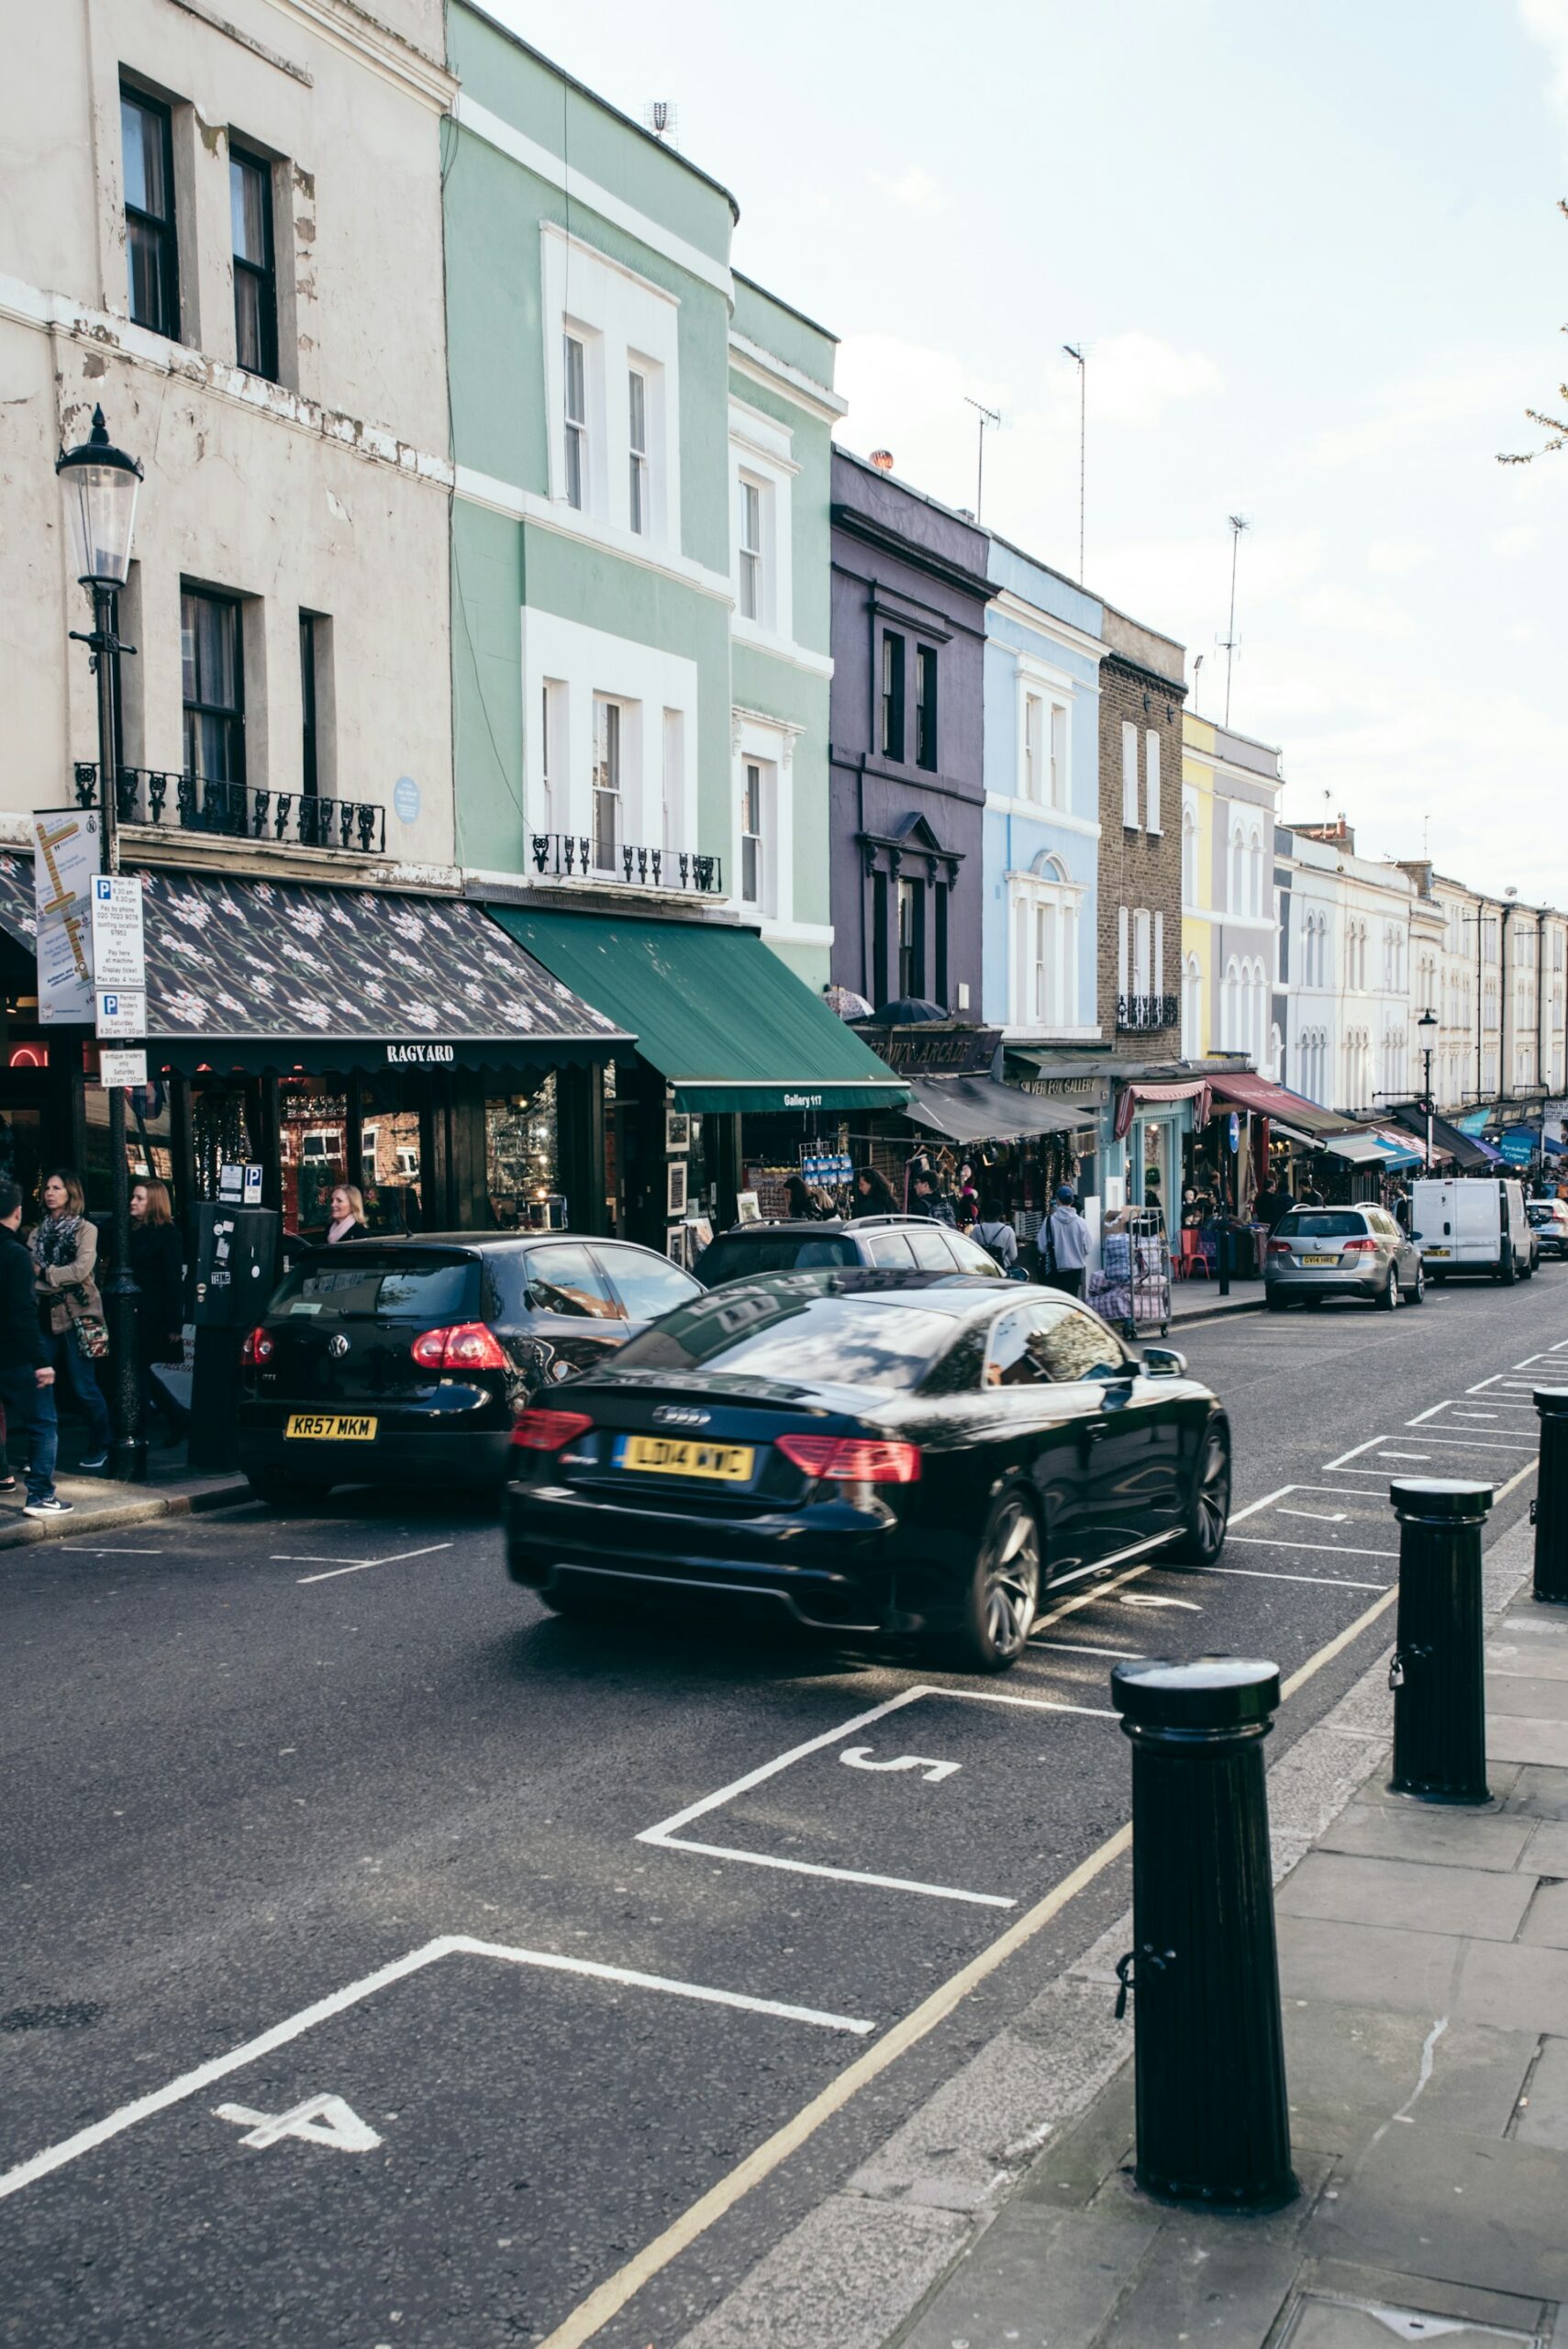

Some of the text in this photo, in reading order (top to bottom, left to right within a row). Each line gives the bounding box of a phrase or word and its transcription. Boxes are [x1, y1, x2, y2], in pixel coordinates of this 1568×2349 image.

[386, 1044, 454, 1063] RAGYARD
[917, 1041, 972, 1063] ARCADE
[1048, 1080, 1063, 1095] FOX
[1064, 1078, 1095, 1093] GALLERY
[784, 1094, 822, 1108] Gallery 117
[293, 1417, 370, 1435] KR57 MKM
[1274, 1508, 1348, 1522] 7
[1118, 1594, 1204, 1610] 6
[839, 1745, 962, 1782] 5
[214, 2092, 384, 2152] 4
